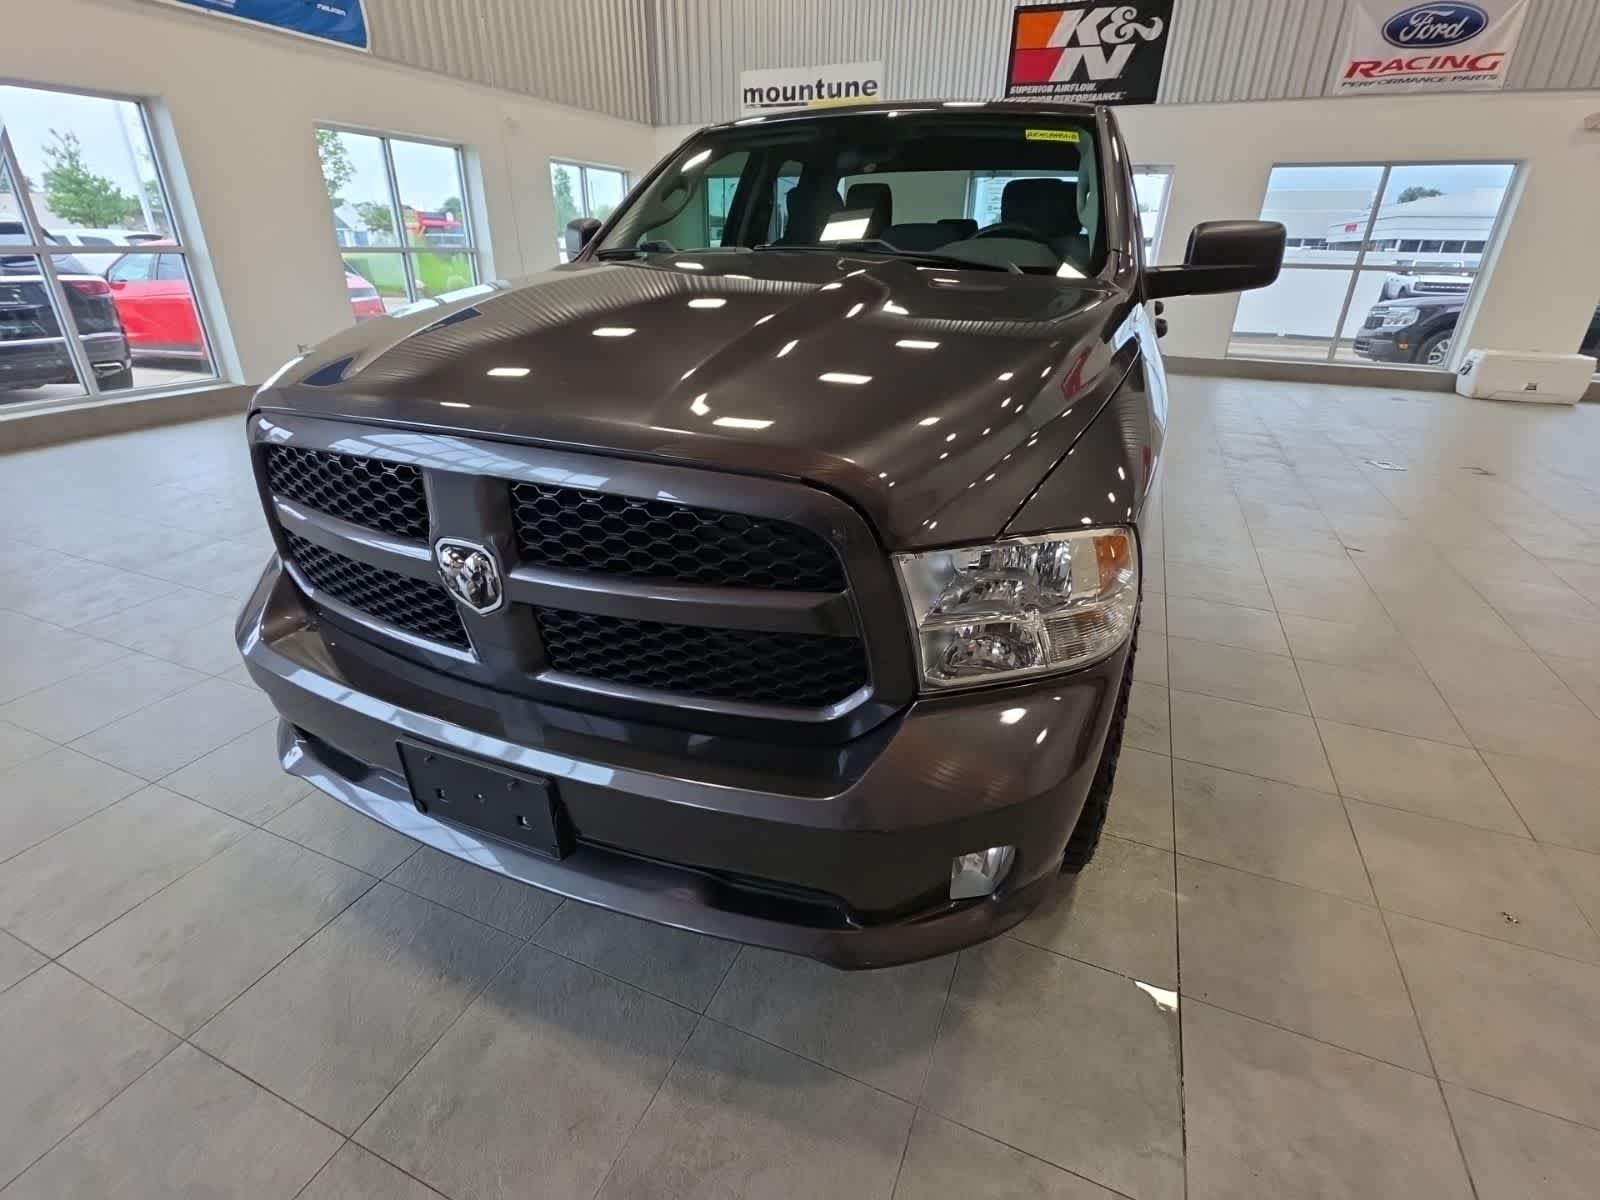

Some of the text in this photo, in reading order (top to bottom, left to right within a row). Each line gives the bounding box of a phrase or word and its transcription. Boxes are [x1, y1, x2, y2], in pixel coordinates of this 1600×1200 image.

[1400, 9, 1470, 42] Ford
[1344, 52, 1505, 79] RACING
[744, 78, 878, 104] mountune
[1009, 84, 1055, 95] SUPERIOR
[1341, 74, 1498, 88] PERFORMANCE PARTS
